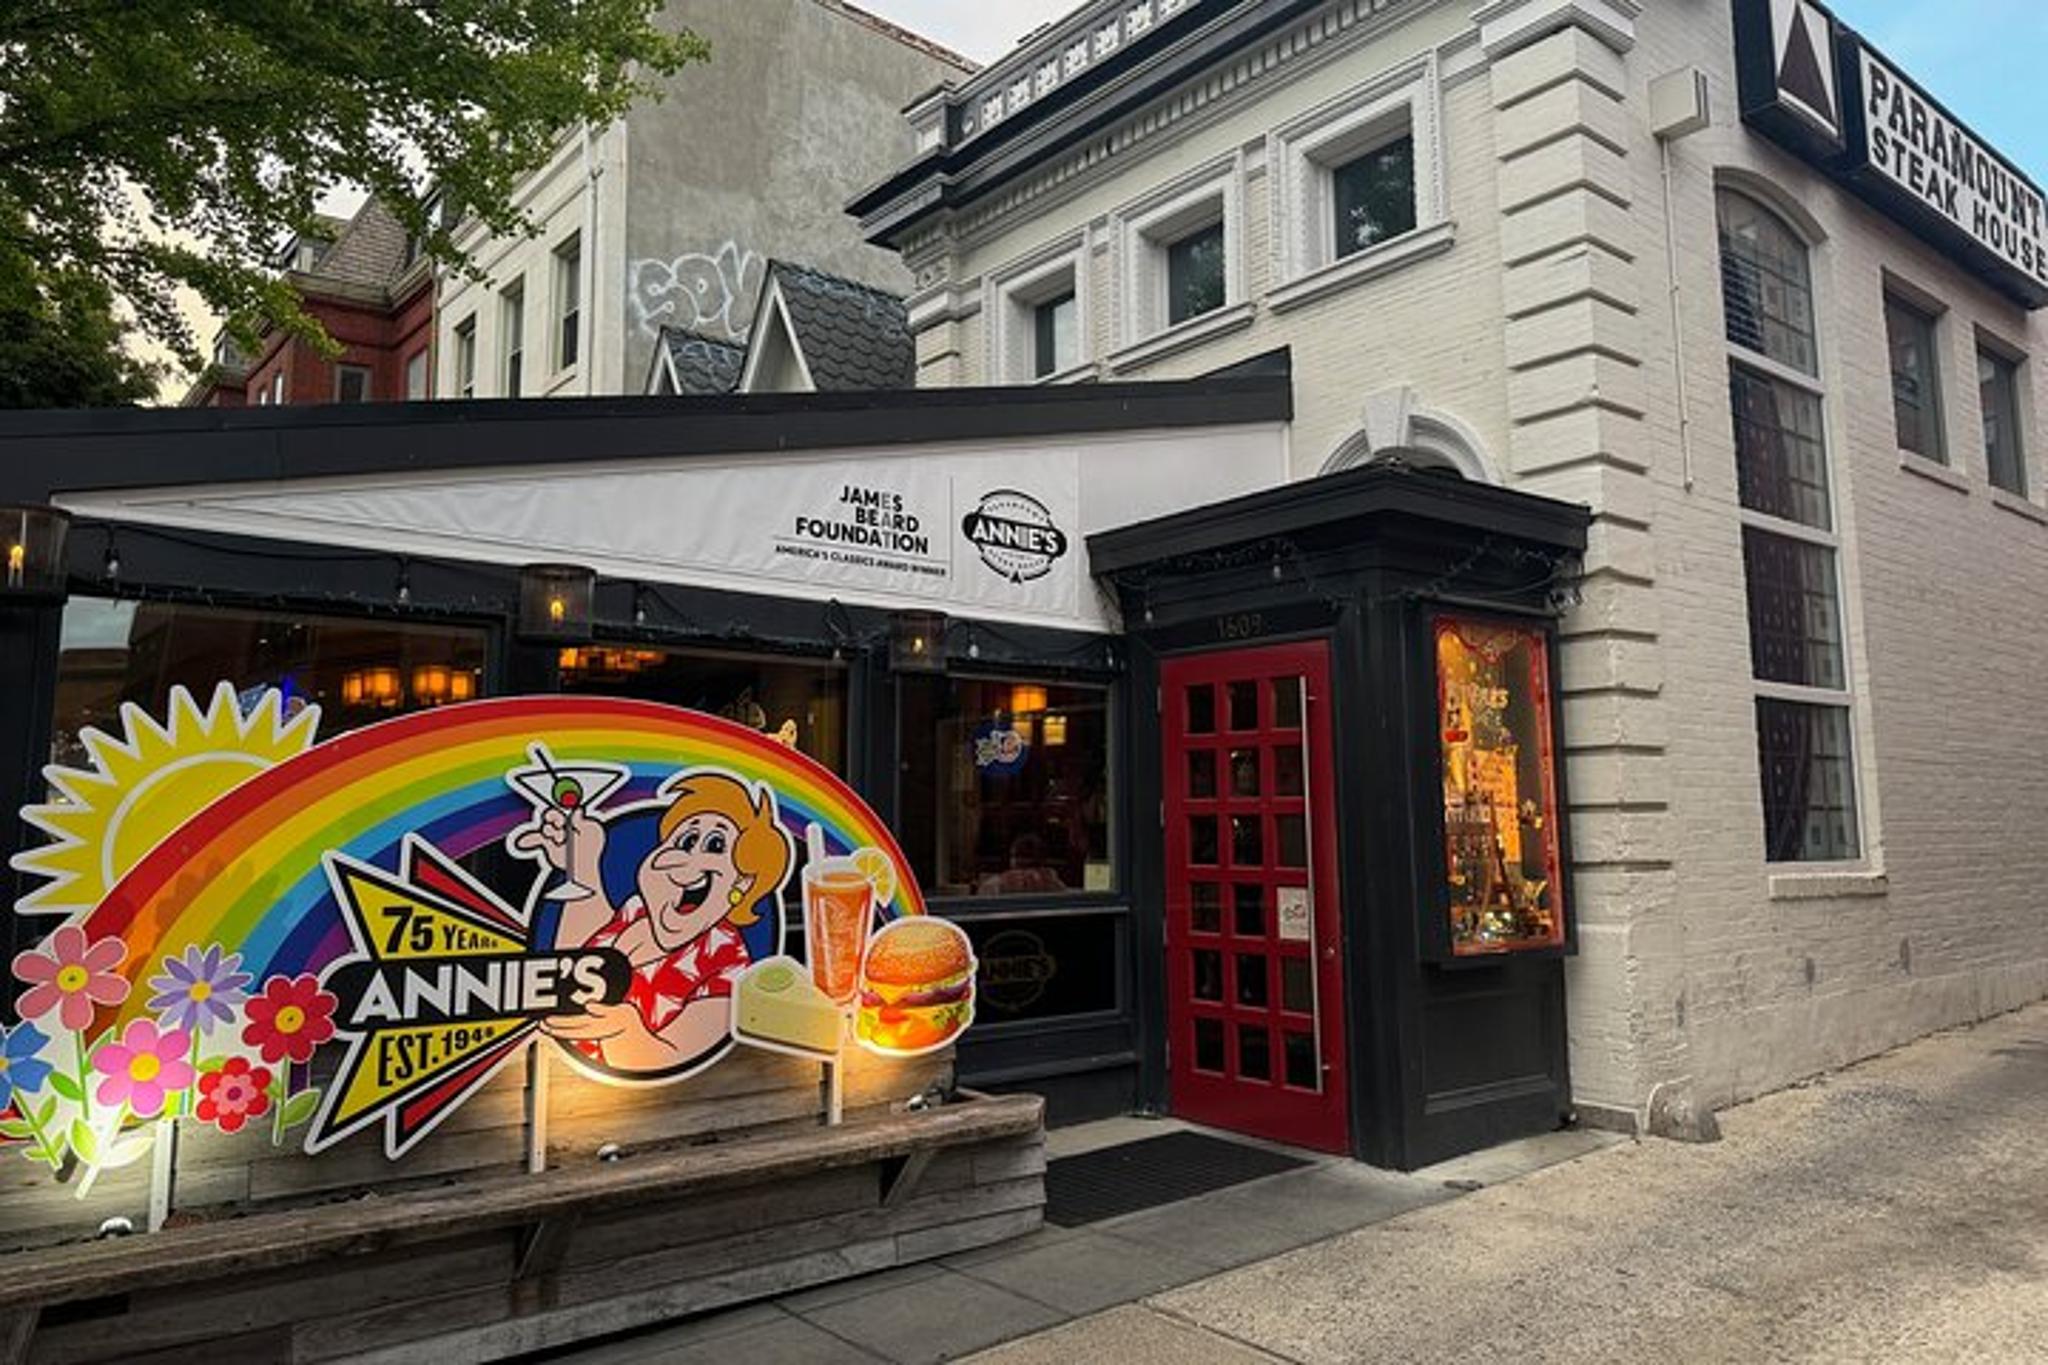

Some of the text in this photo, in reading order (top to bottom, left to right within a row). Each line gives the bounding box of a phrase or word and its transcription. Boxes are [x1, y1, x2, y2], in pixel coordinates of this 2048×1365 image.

[1868, 61, 2042, 240] PARAMOUNT
[1871, 126, 2047, 280] STEAK HOUSE
[838, 485, 903, 513] JAMES
[855, 504, 920, 533] BEARD
[795, 516, 929, 555] FOUNDATION
[972, 517, 1059, 555] ANNIE'S
[381, 905, 434, 954] 75
[350, 955, 607, 1023] ANNIE'S
